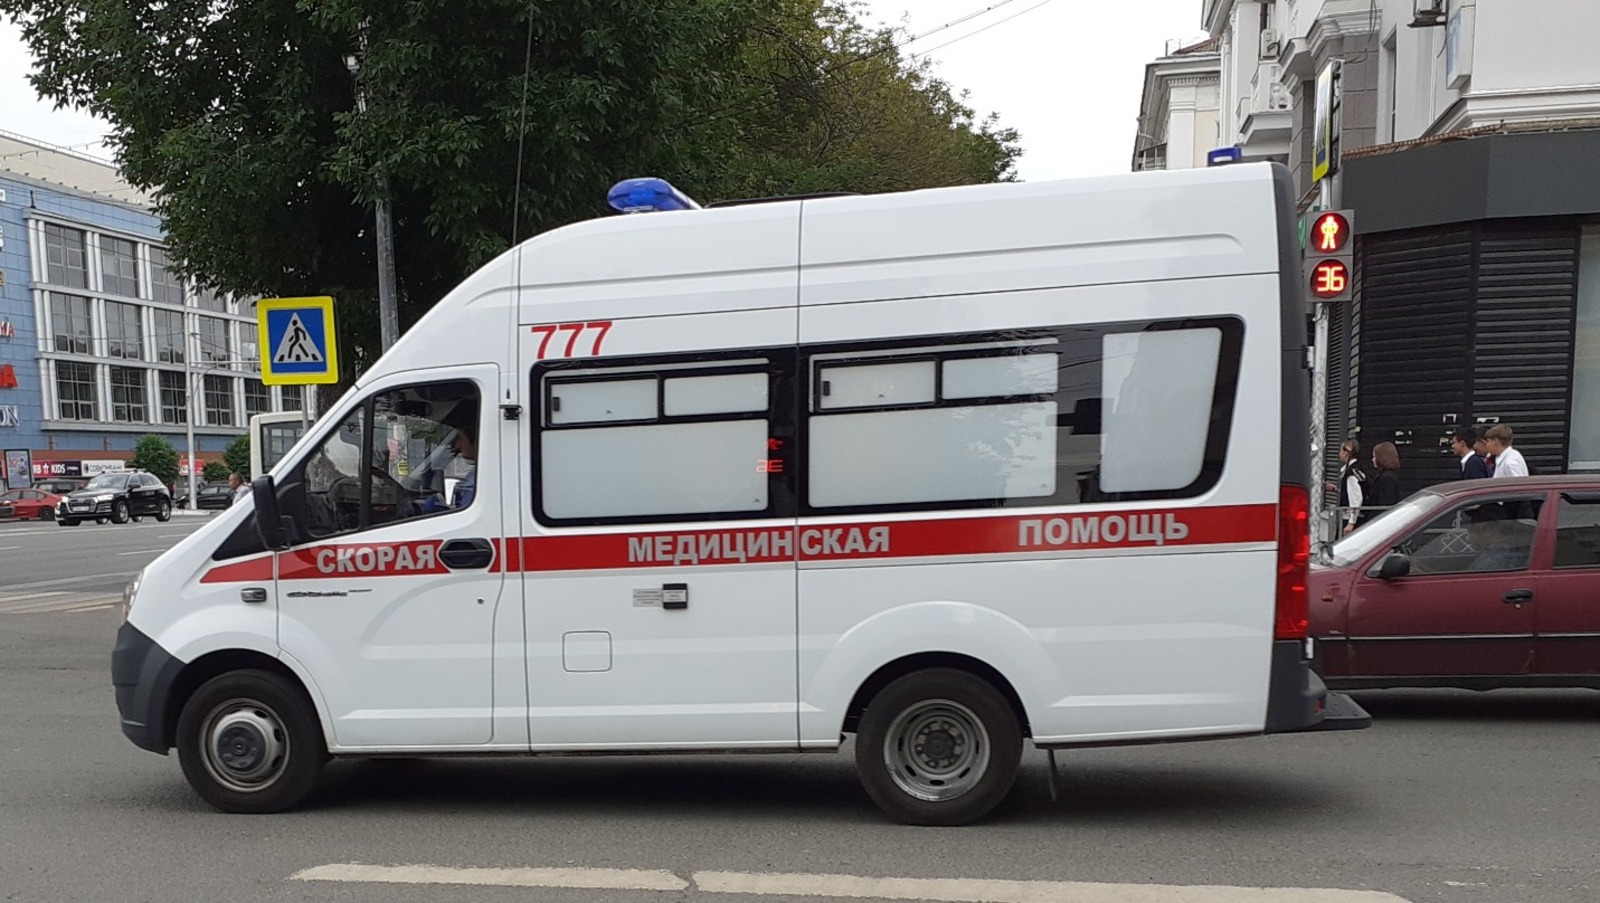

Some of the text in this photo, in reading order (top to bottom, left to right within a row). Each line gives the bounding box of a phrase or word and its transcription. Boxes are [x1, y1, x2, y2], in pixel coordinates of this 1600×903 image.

[1317, 266, 1344, 292] 36
[531, 321, 613, 360] 777
[50, 464, 66, 474] KIDS
[316, 513, 1189, 573] СКОРАЯ МЕДИЦИНСКАЯ ПОМОЩЬ
